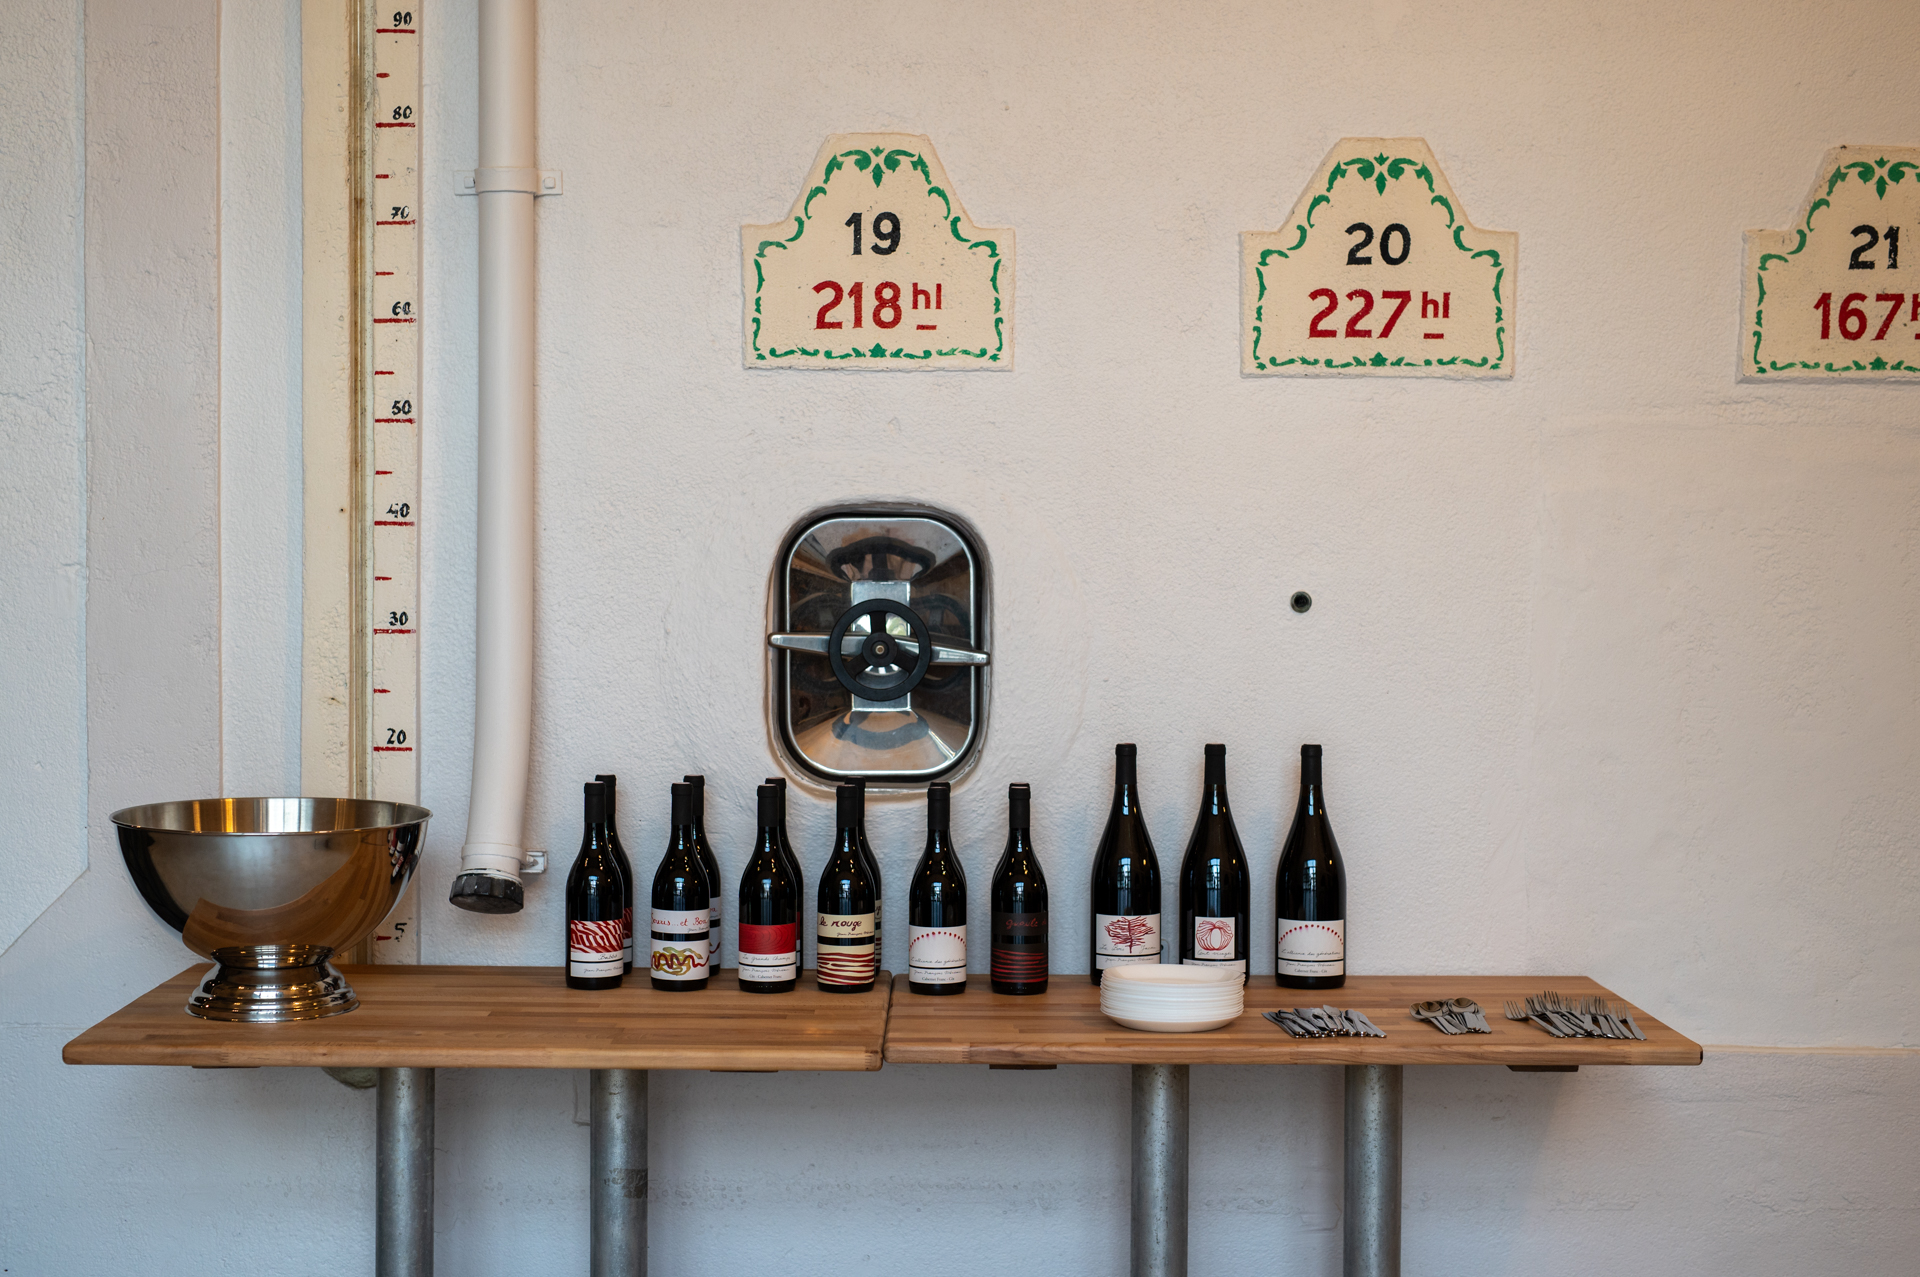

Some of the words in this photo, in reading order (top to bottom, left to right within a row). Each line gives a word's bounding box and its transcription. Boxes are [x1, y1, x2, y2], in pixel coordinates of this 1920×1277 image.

[393, 12, 412, 28] 90
[392, 106, 412, 120] 80
[390, 205, 410, 220] 70
[844, 211, 901, 256] 19
[1344, 222, 1411, 266] 20
[1848, 224, 1900, 270] 21
[391, 301, 411, 316] 60
[391, 400, 412, 416] 50
[386, 503, 410, 518] 40
[388, 611, 408, 626] 30
[386, 728, 406, 745] 20
[831, 920, 863, 932] rouge
